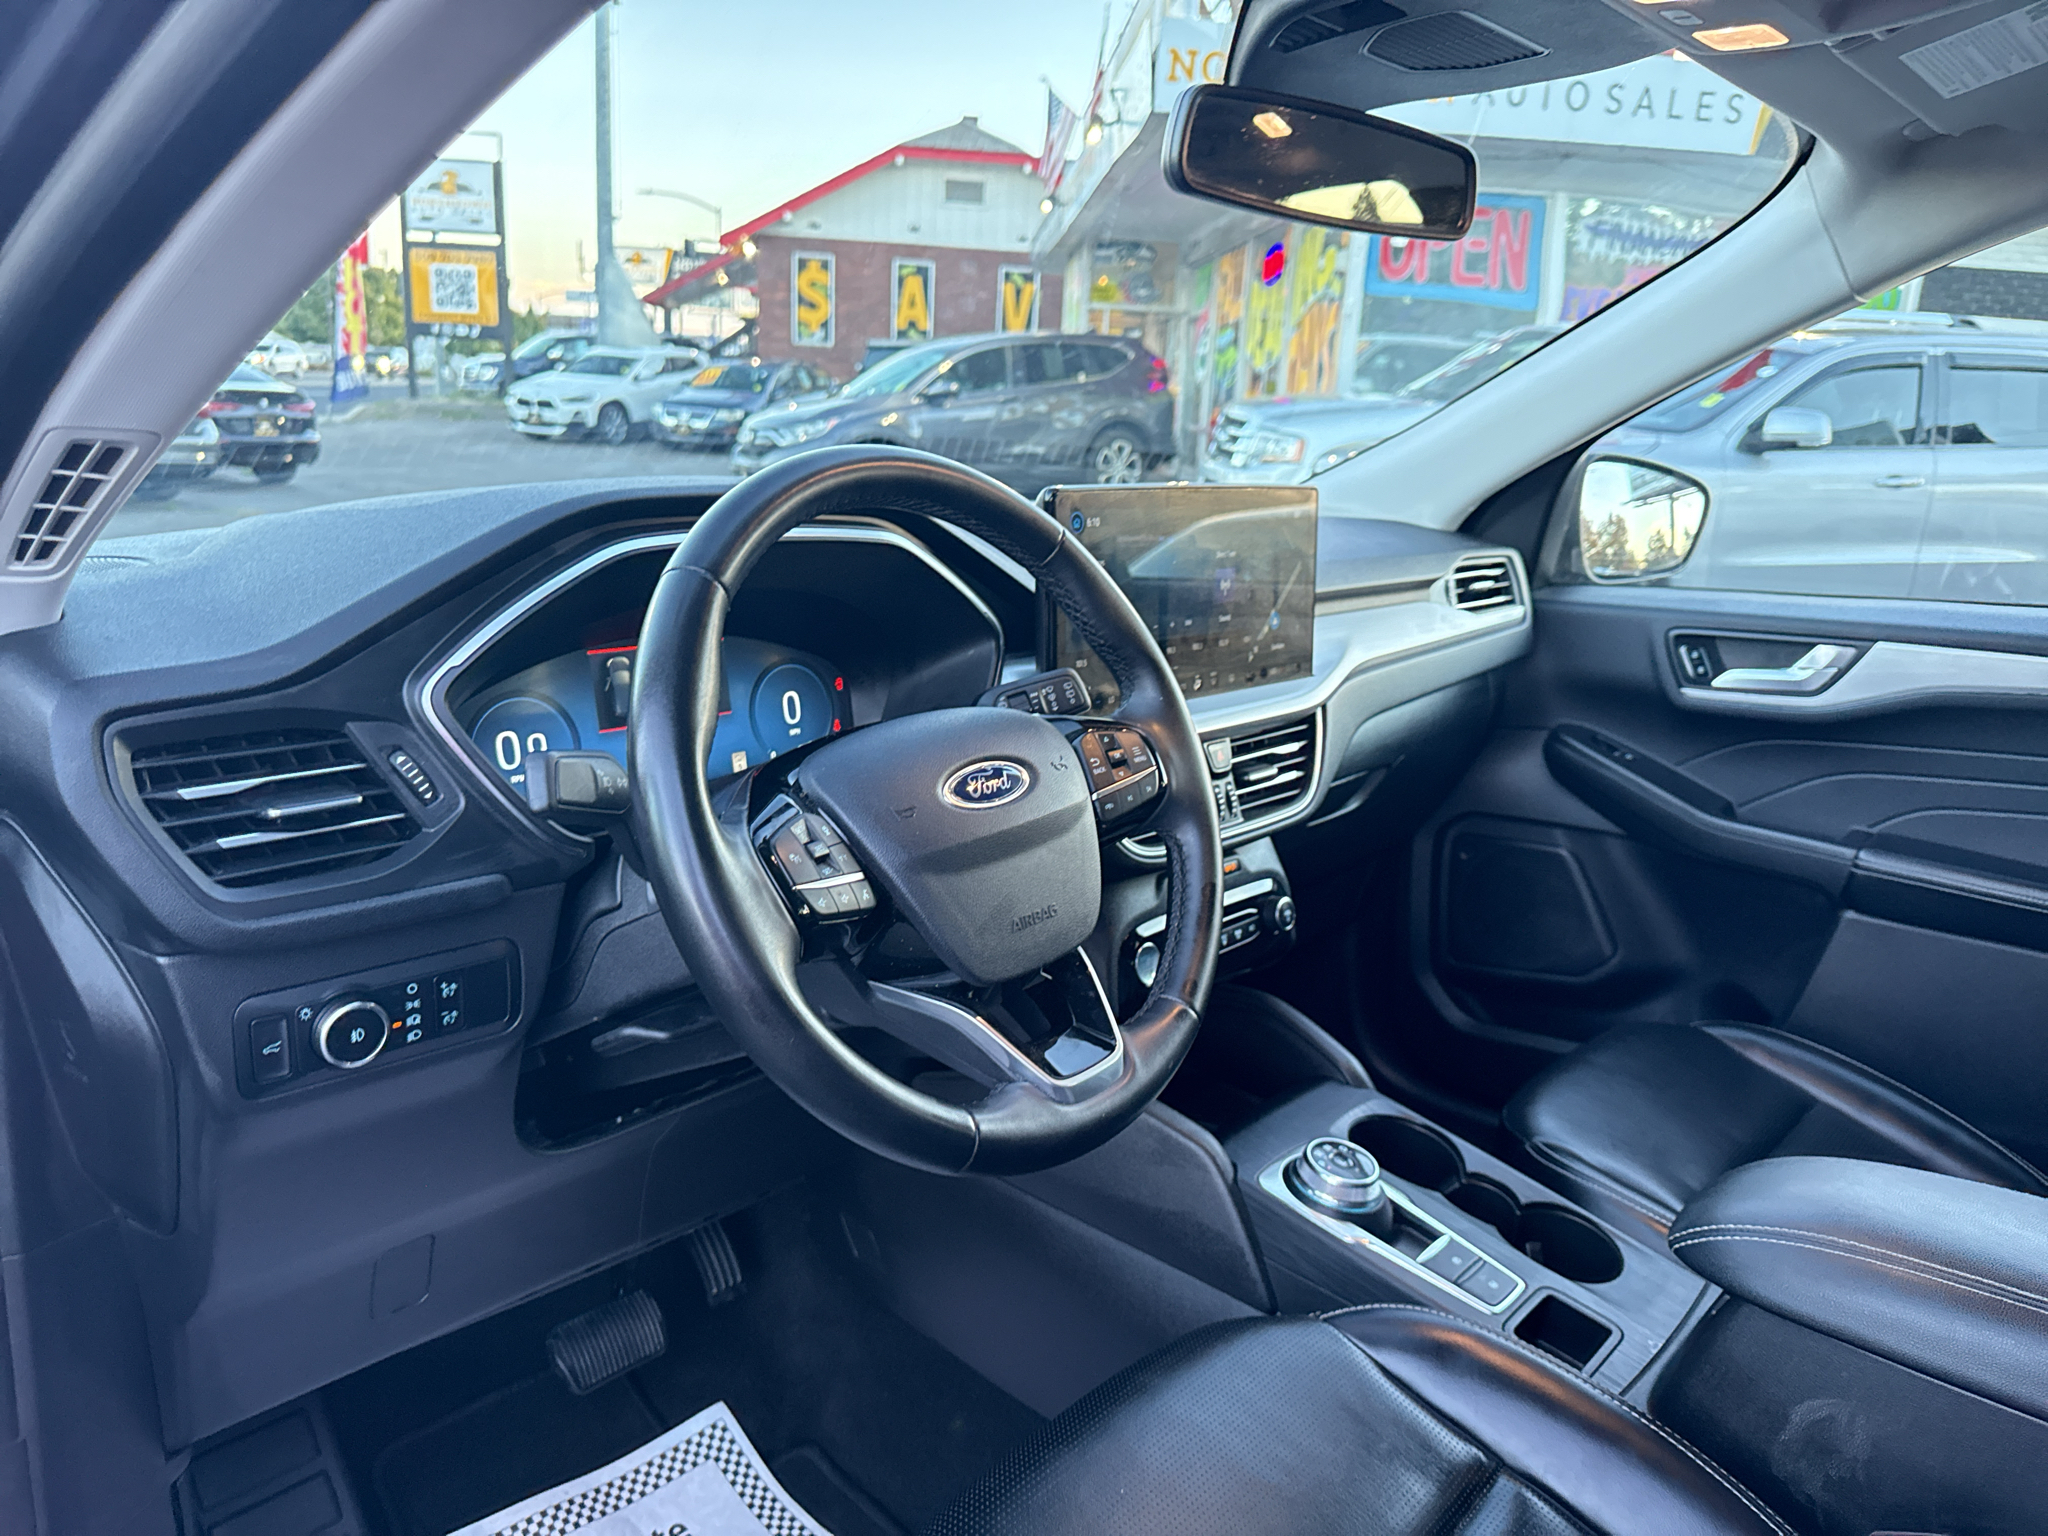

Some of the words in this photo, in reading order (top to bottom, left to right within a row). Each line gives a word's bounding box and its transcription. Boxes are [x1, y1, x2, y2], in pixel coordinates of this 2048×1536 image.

[1378, 207, 1532, 291] OPEN
[782, 690, 801, 725] 0
[966, 769, 1012, 799] Ford
[1011, 903, 1058, 934] AIRBAG
